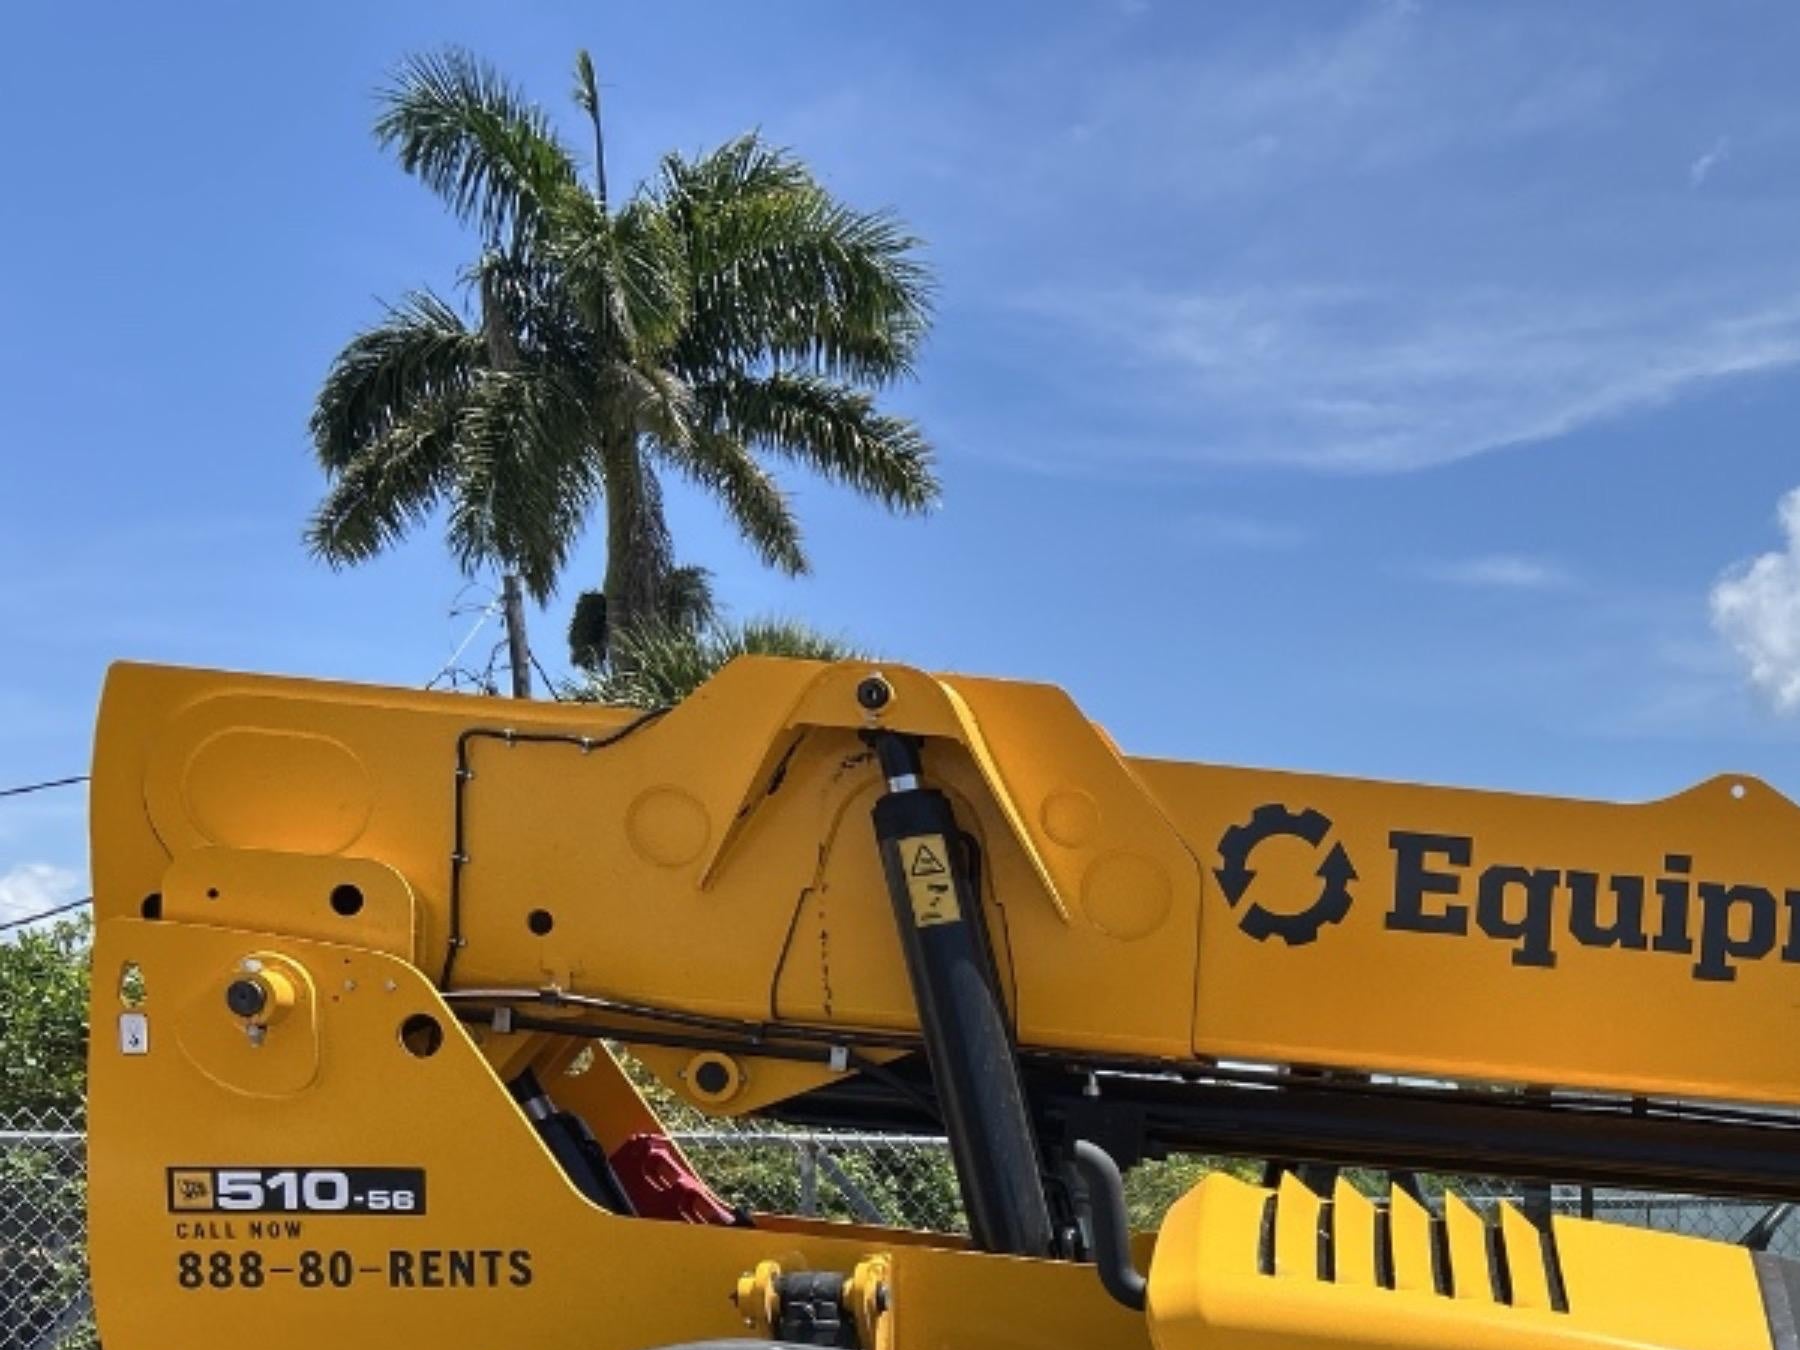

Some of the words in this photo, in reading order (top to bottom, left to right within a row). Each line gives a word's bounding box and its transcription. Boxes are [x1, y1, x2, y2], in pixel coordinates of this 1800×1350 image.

[176, 1222, 237, 1239] CALL
[249, 1222, 301, 1239] NOW
[178, 1249, 533, 1289] 888-80-RENTS
